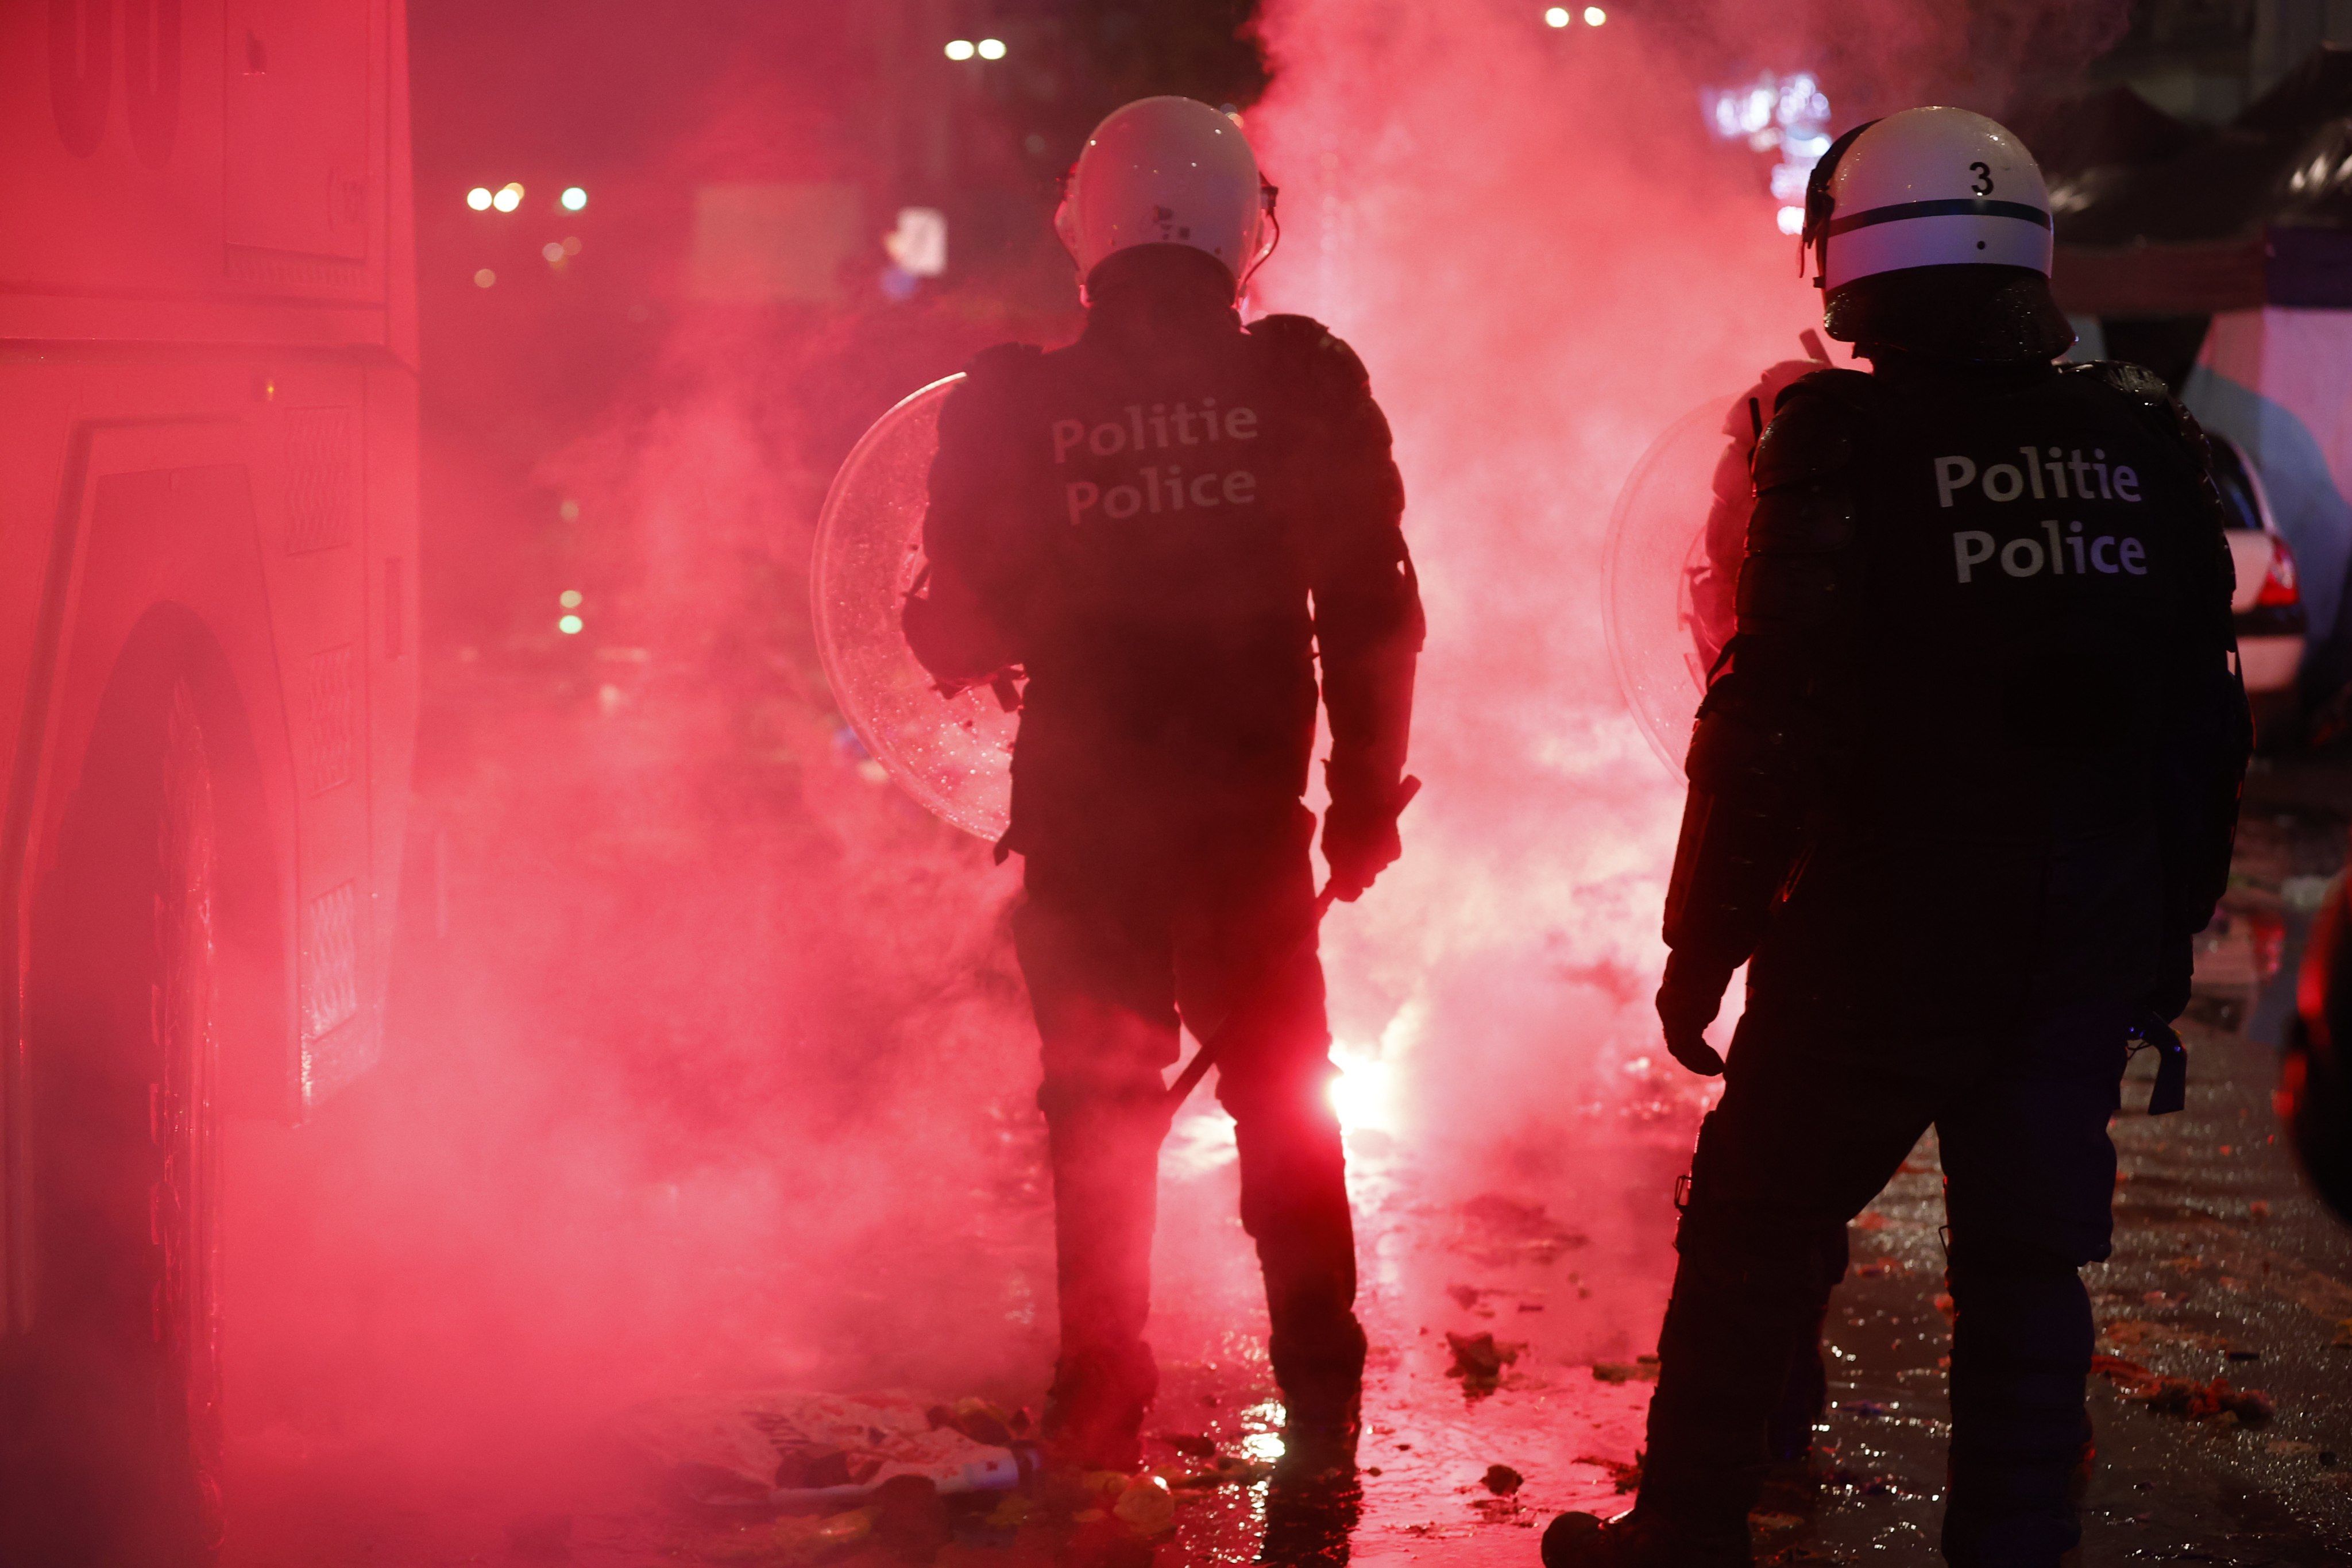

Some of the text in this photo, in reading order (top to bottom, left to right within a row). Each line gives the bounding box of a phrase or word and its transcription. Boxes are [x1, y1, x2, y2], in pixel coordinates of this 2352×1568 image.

[1969, 162, 1994, 195] 3
[1052, 397, 1258, 463] Politie
[1066, 465, 1257, 526] Police
[1933, 446, 2142, 508] Politie
[1953, 520, 2148, 584] Police
